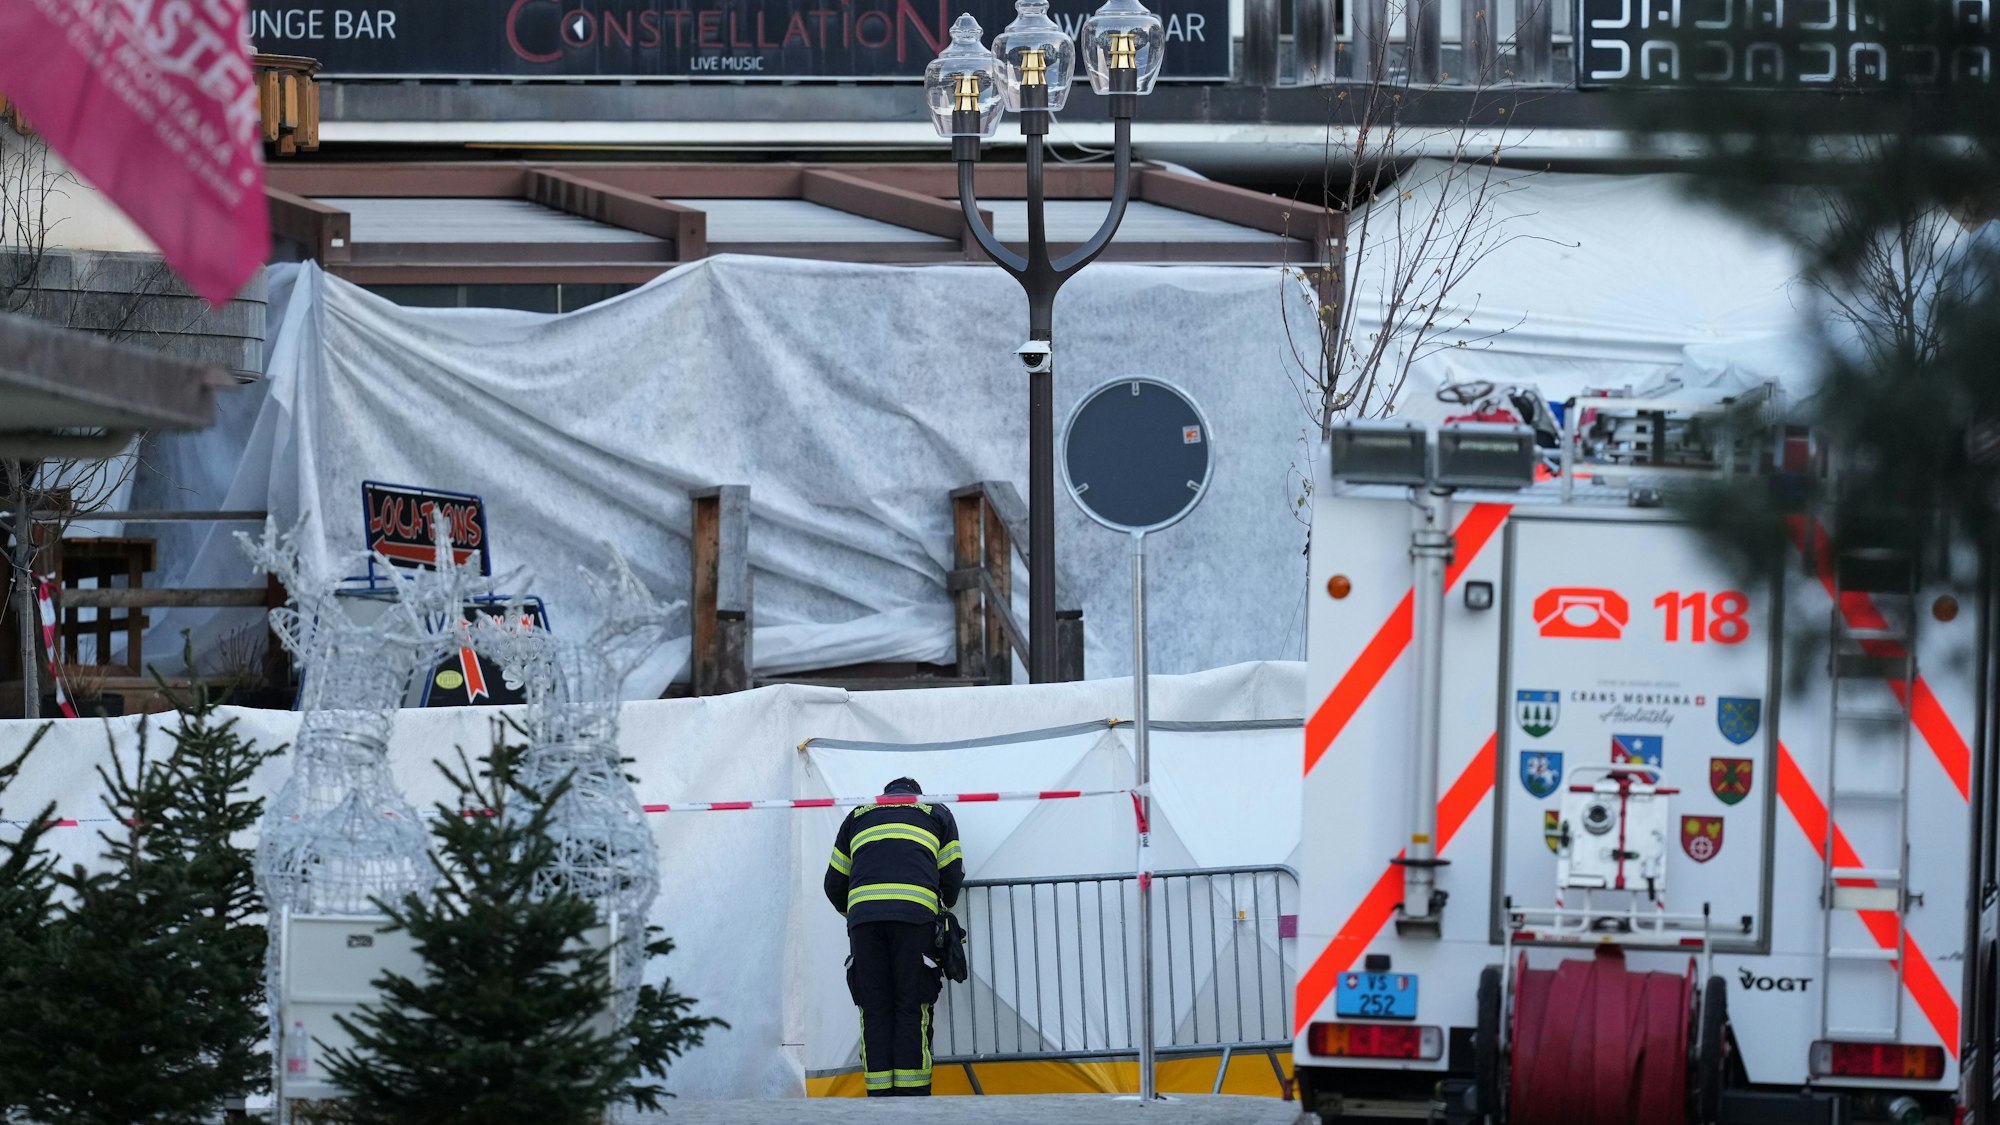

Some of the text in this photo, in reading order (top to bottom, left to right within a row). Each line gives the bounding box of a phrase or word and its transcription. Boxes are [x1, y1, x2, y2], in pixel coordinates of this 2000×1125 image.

[335, 9, 396, 39] BAR
[1155, 13, 1205, 42] AR
[690, 56, 764, 71] LIVE MUSIC
[368, 493, 482, 547] LOCATONS
[1654, 589, 1750, 645] 118
[1570, 691, 1692, 706] CRANS MONTANA
[1368, 974, 1388, 991] VS
[1738, 966, 1814, 992] VOGT
[1360, 994, 1396, 1015] 252
